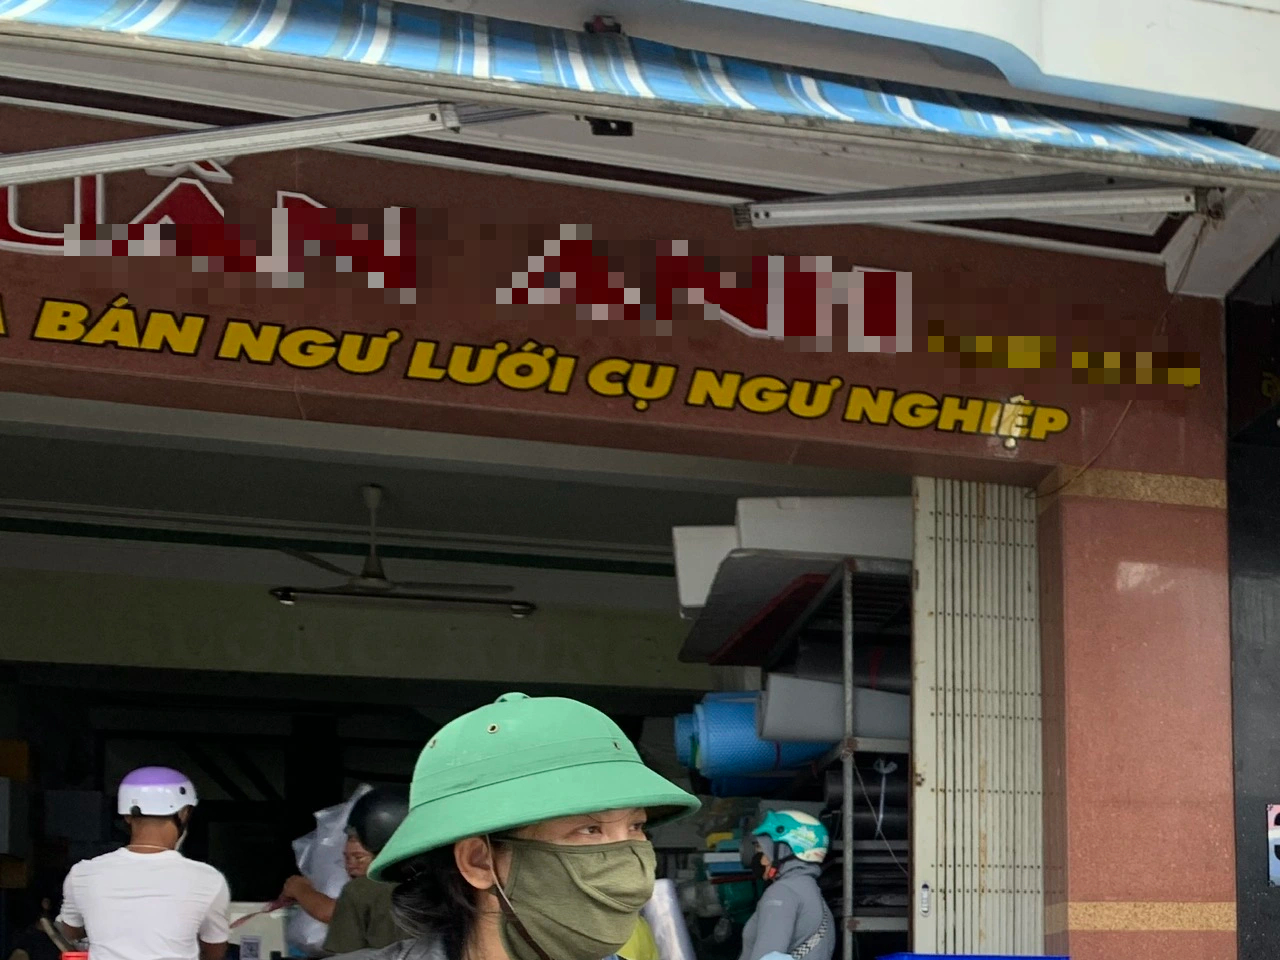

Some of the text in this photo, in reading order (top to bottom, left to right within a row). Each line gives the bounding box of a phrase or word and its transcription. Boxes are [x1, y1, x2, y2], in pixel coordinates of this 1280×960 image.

[32, 294, 208, 356] BÁN
[215, 317, 402, 375] NGƯ
[405, 339, 579, 394] LƯỚI
[587, 357, 679, 412] CỤ
[685, 367, 844, 418] NGƯ
[843, 385, 1070, 449] NGHIỆP
